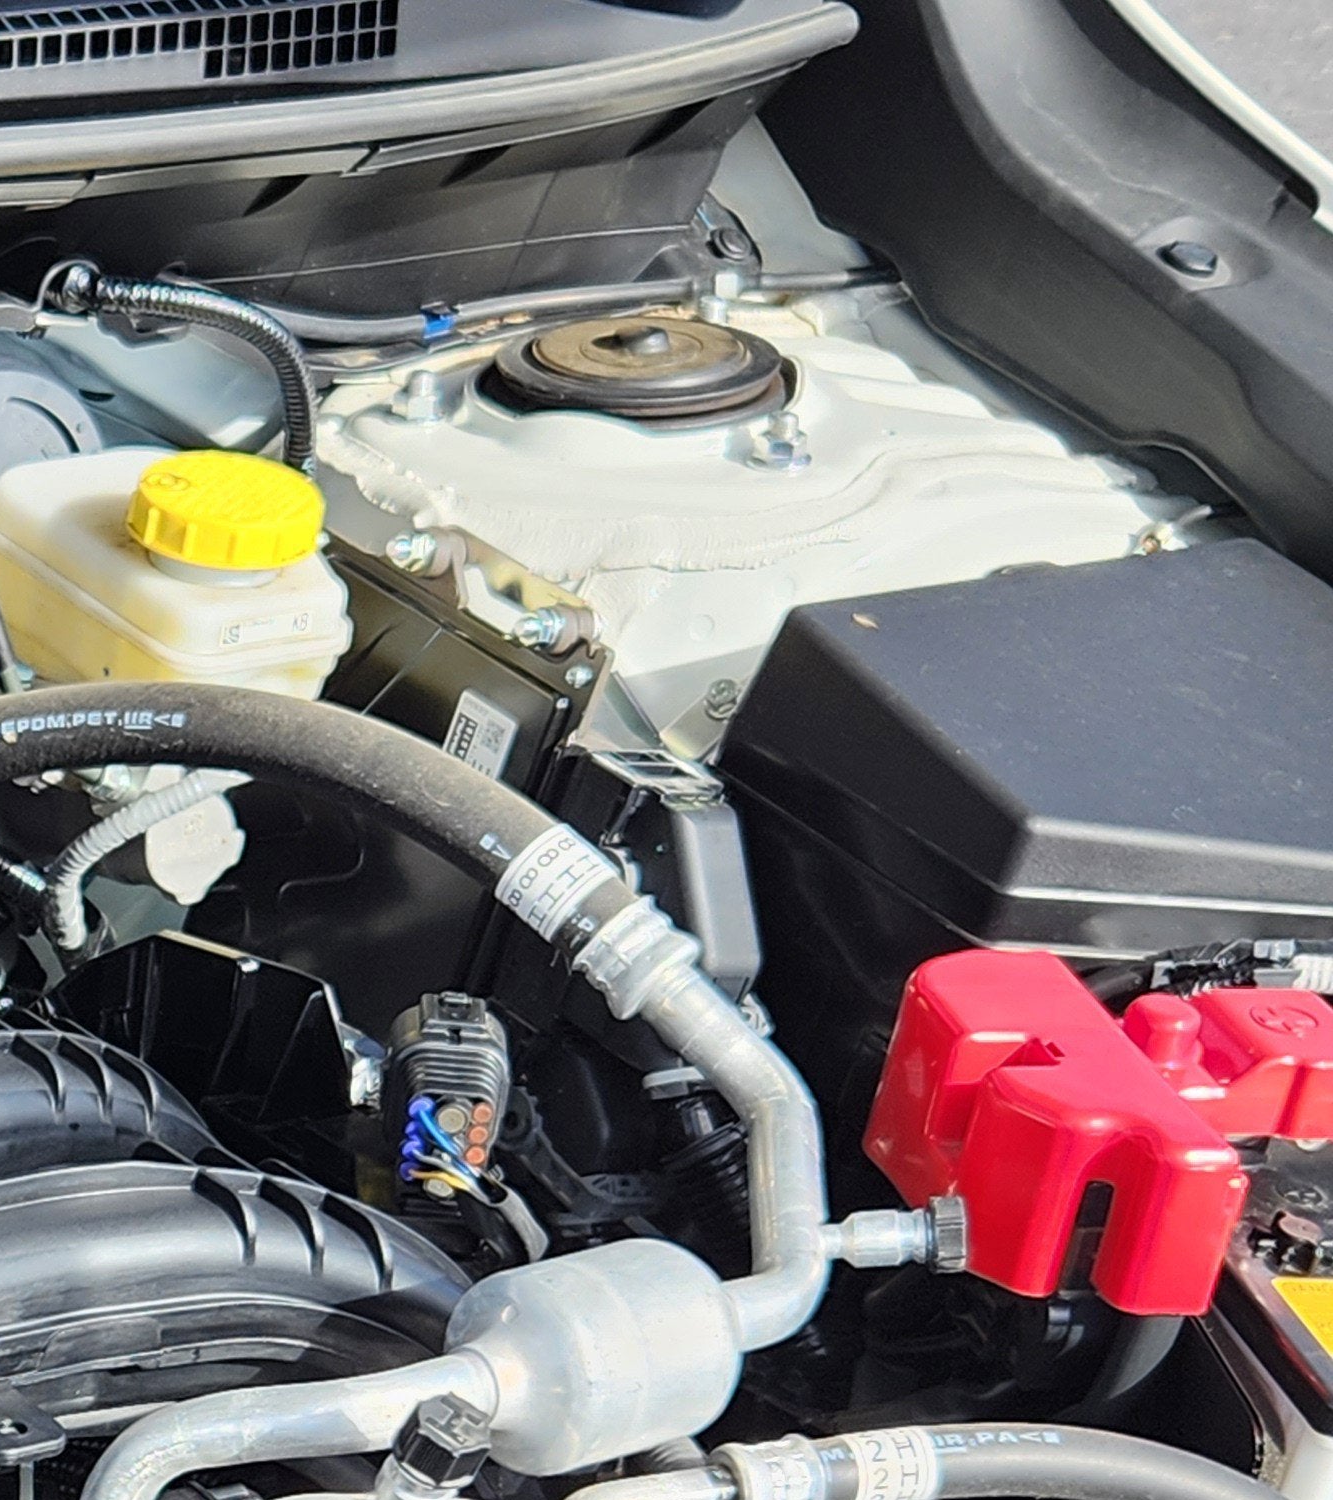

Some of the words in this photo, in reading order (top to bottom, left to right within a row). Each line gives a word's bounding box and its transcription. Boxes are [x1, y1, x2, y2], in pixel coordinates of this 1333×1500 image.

[537, 848, 559, 868] 8
[555, 864, 585, 890] H
[577, 853, 601, 873] H
[519, 867, 539, 890] 8
[536, 882, 565, 912] H
[866, 1439, 886, 1463] 2
[891, 1434, 918, 1460] H
[873, 1467, 889, 1490] 2
[900, 1463, 920, 1488] H
